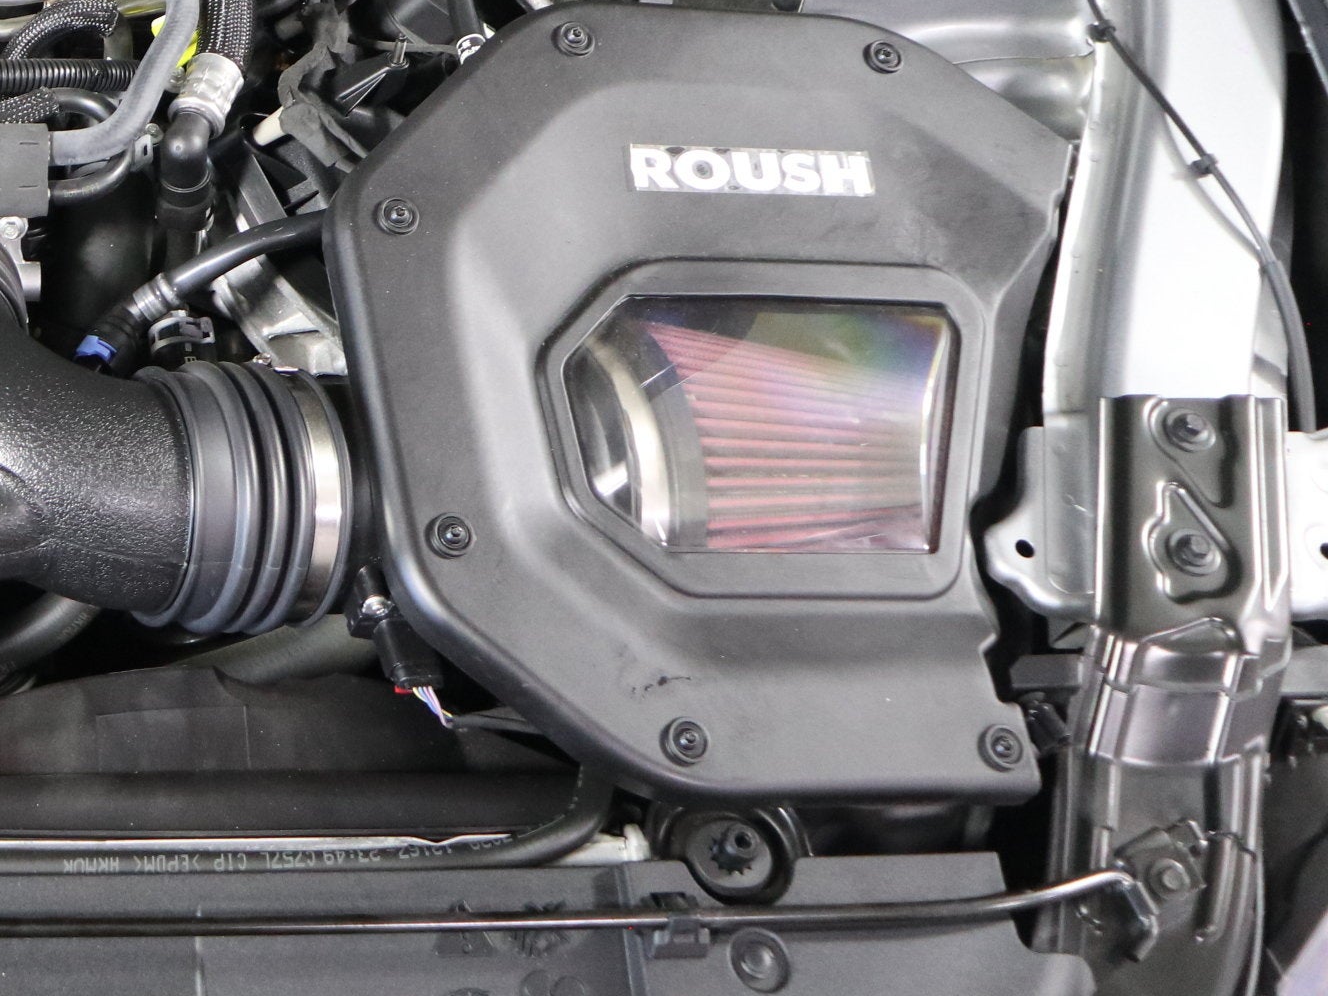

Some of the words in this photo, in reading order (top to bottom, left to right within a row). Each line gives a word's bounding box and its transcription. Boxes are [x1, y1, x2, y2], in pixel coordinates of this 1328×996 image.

[629, 146, 876, 197] ROUSH
[213, 853, 248, 871] CIP
[264, 851, 317, 869] C757L
